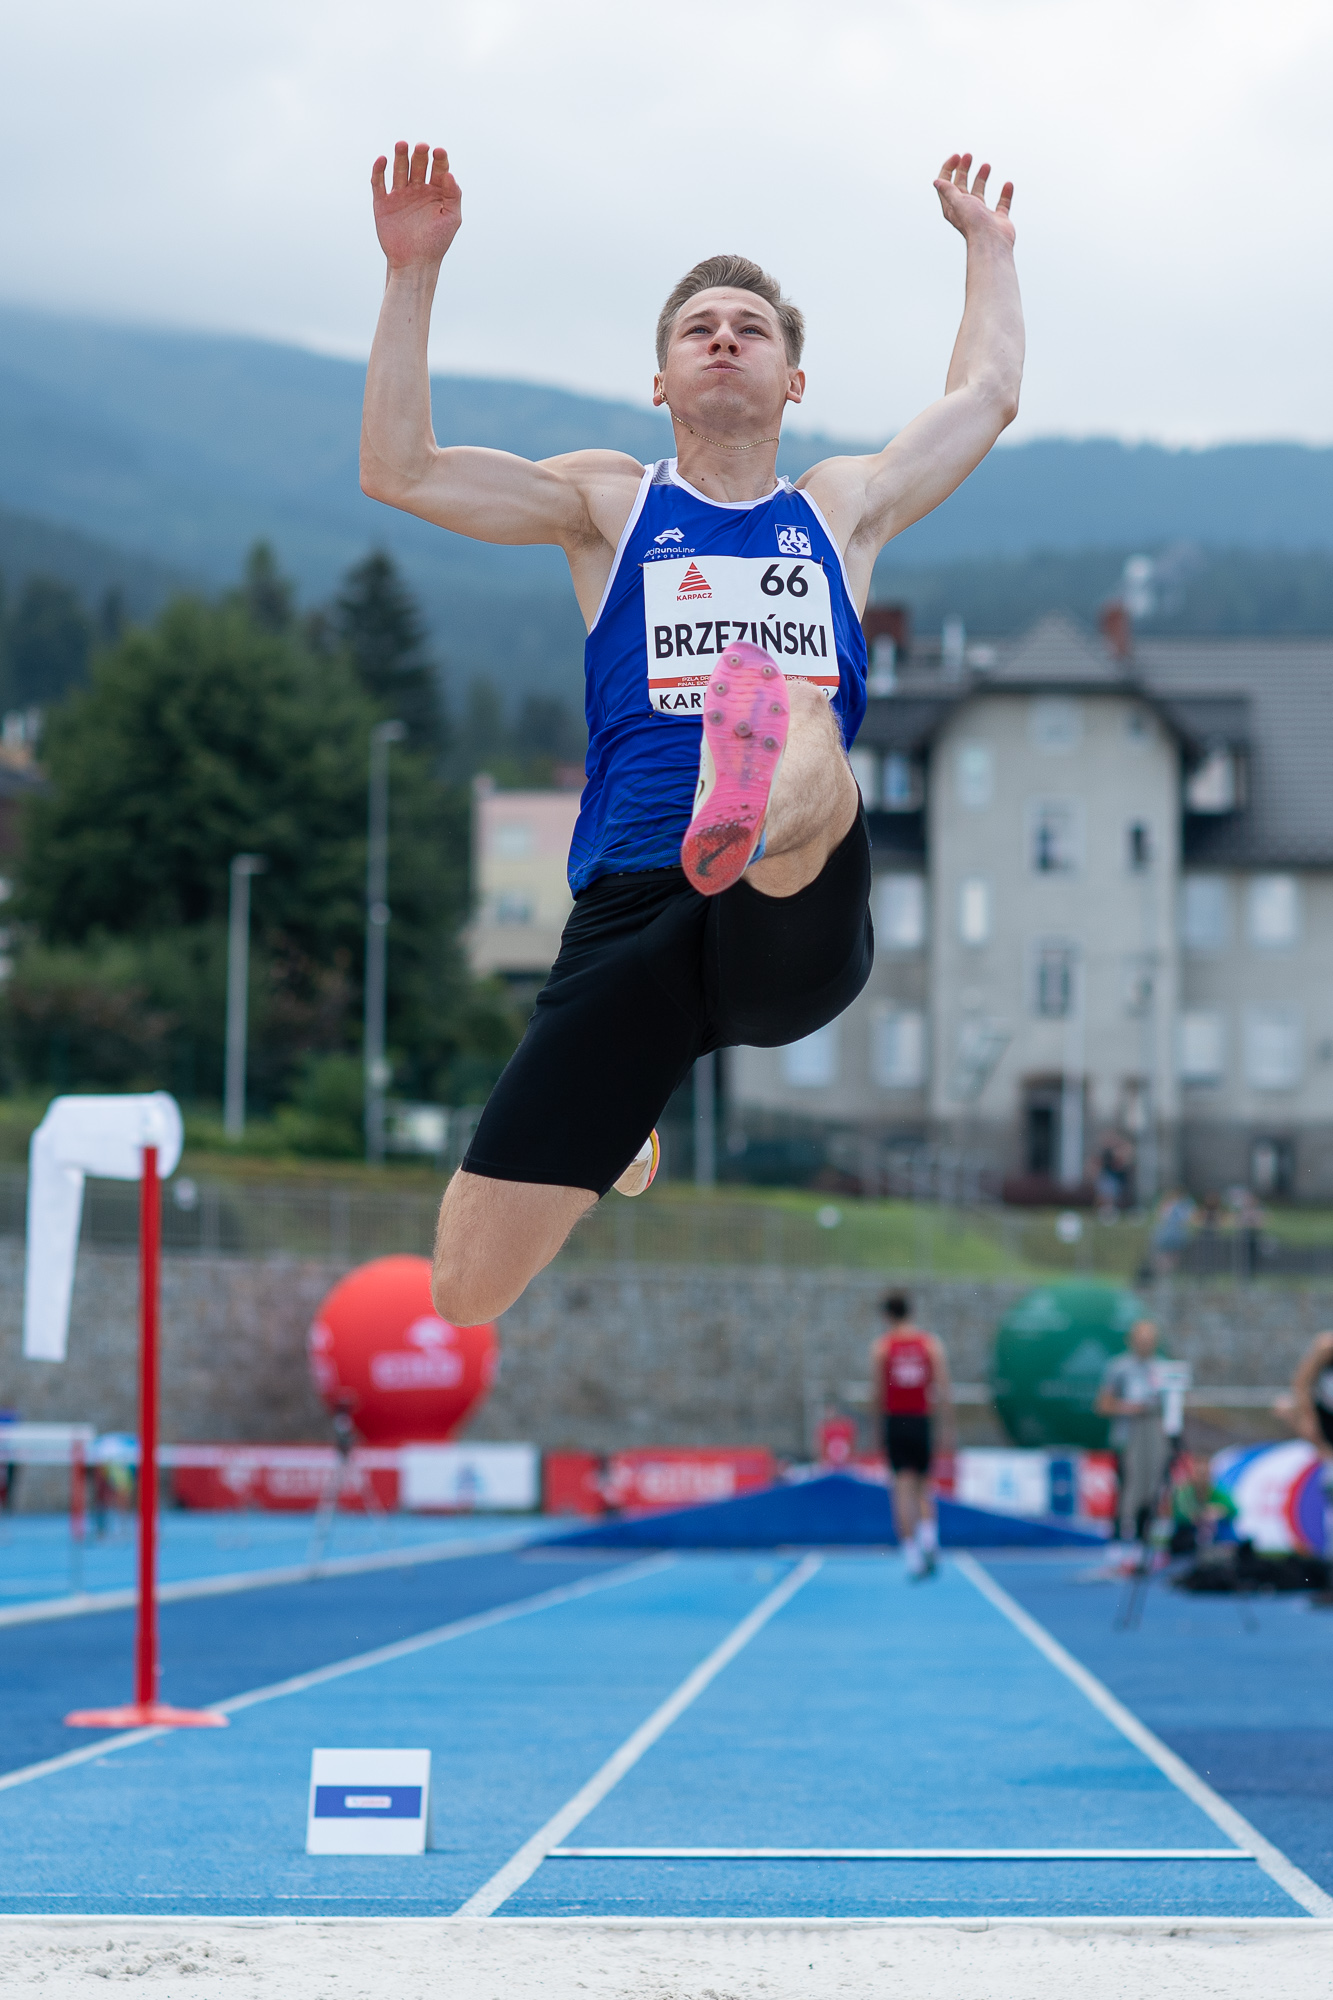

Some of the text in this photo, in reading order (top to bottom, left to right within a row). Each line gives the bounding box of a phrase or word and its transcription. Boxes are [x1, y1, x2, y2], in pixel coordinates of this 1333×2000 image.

[760, 563, 809, 598] 66
[676, 592, 713, 601] KARPACZ
[654, 613, 828, 659] BRZEZIŃSKI
[659, 692, 707, 710] KAR
